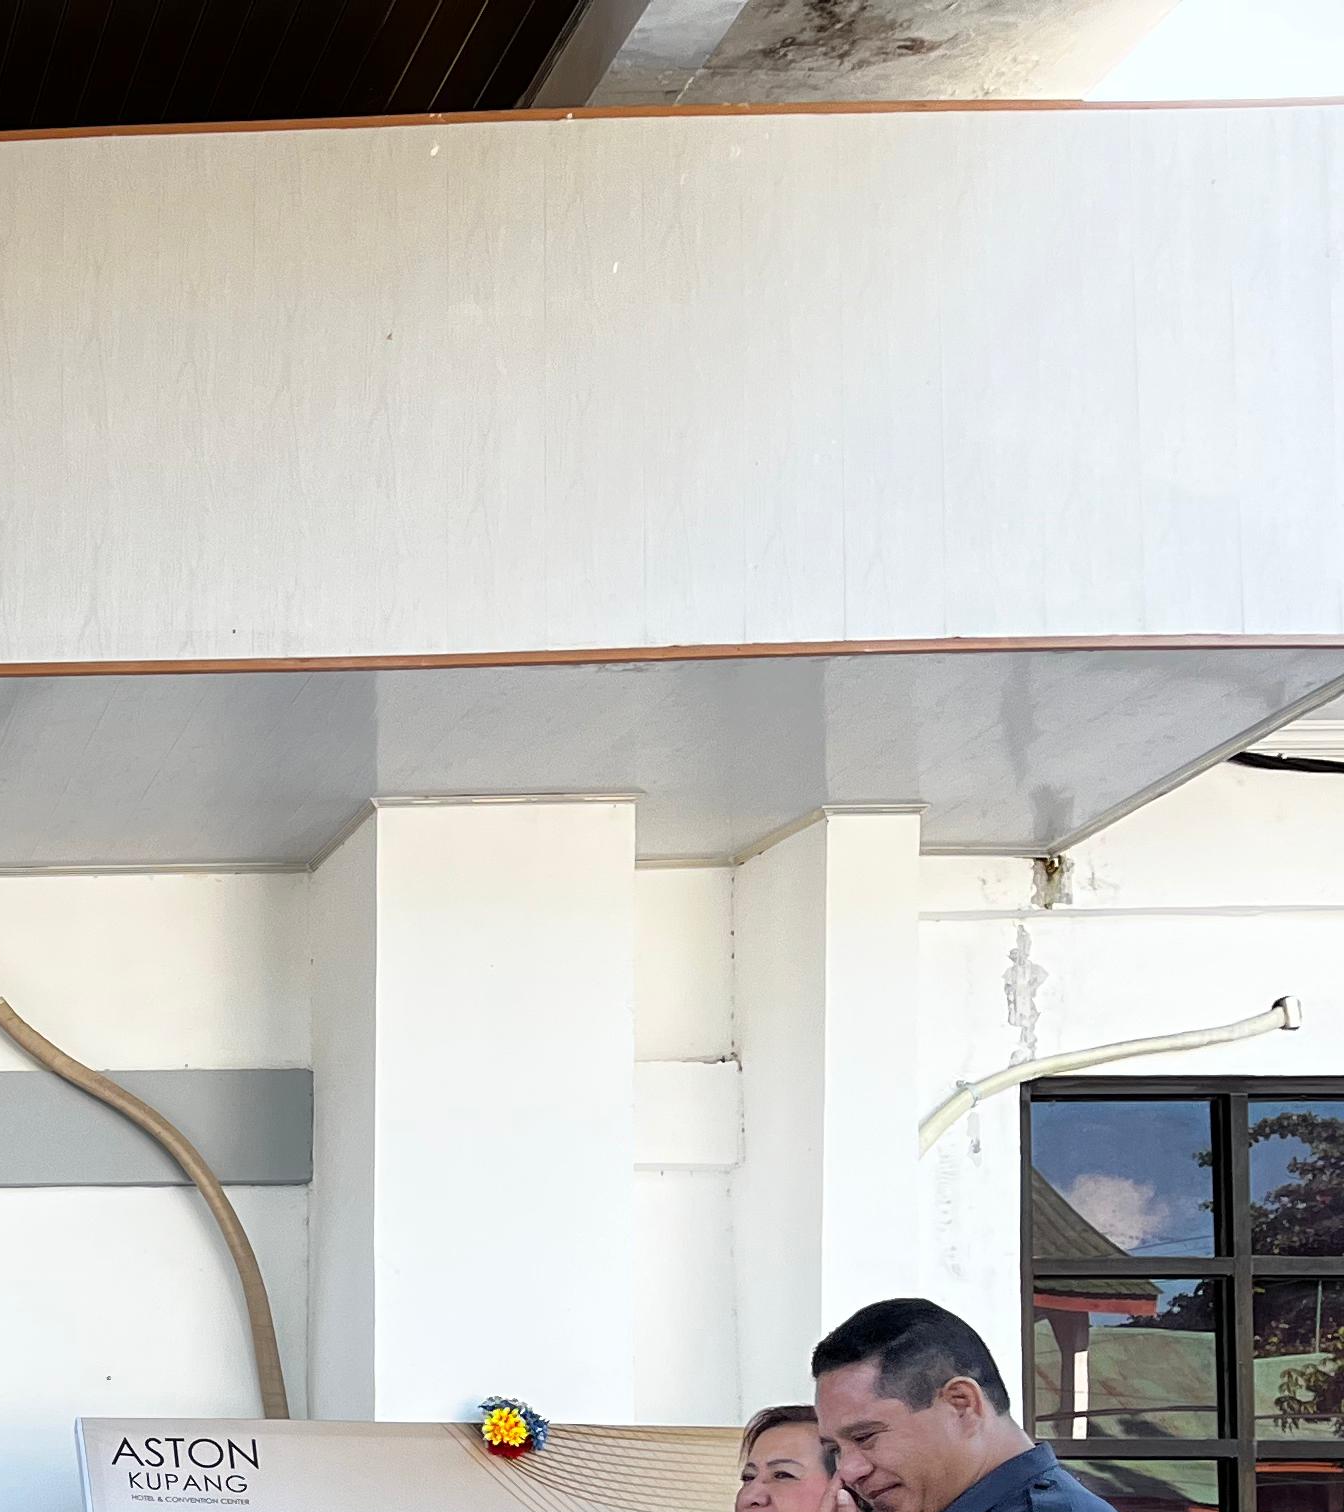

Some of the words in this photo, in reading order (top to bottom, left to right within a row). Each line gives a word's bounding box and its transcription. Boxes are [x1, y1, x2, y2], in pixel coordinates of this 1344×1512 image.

[112, 1436, 260, 1470] ASTON
[128, 1471, 248, 1494] KUPANG
[131, 1494, 155, 1502] HOTEL
[164, 1496, 219, 1504] CONVENTION
[220, 1497, 250, 1505] CENTER
